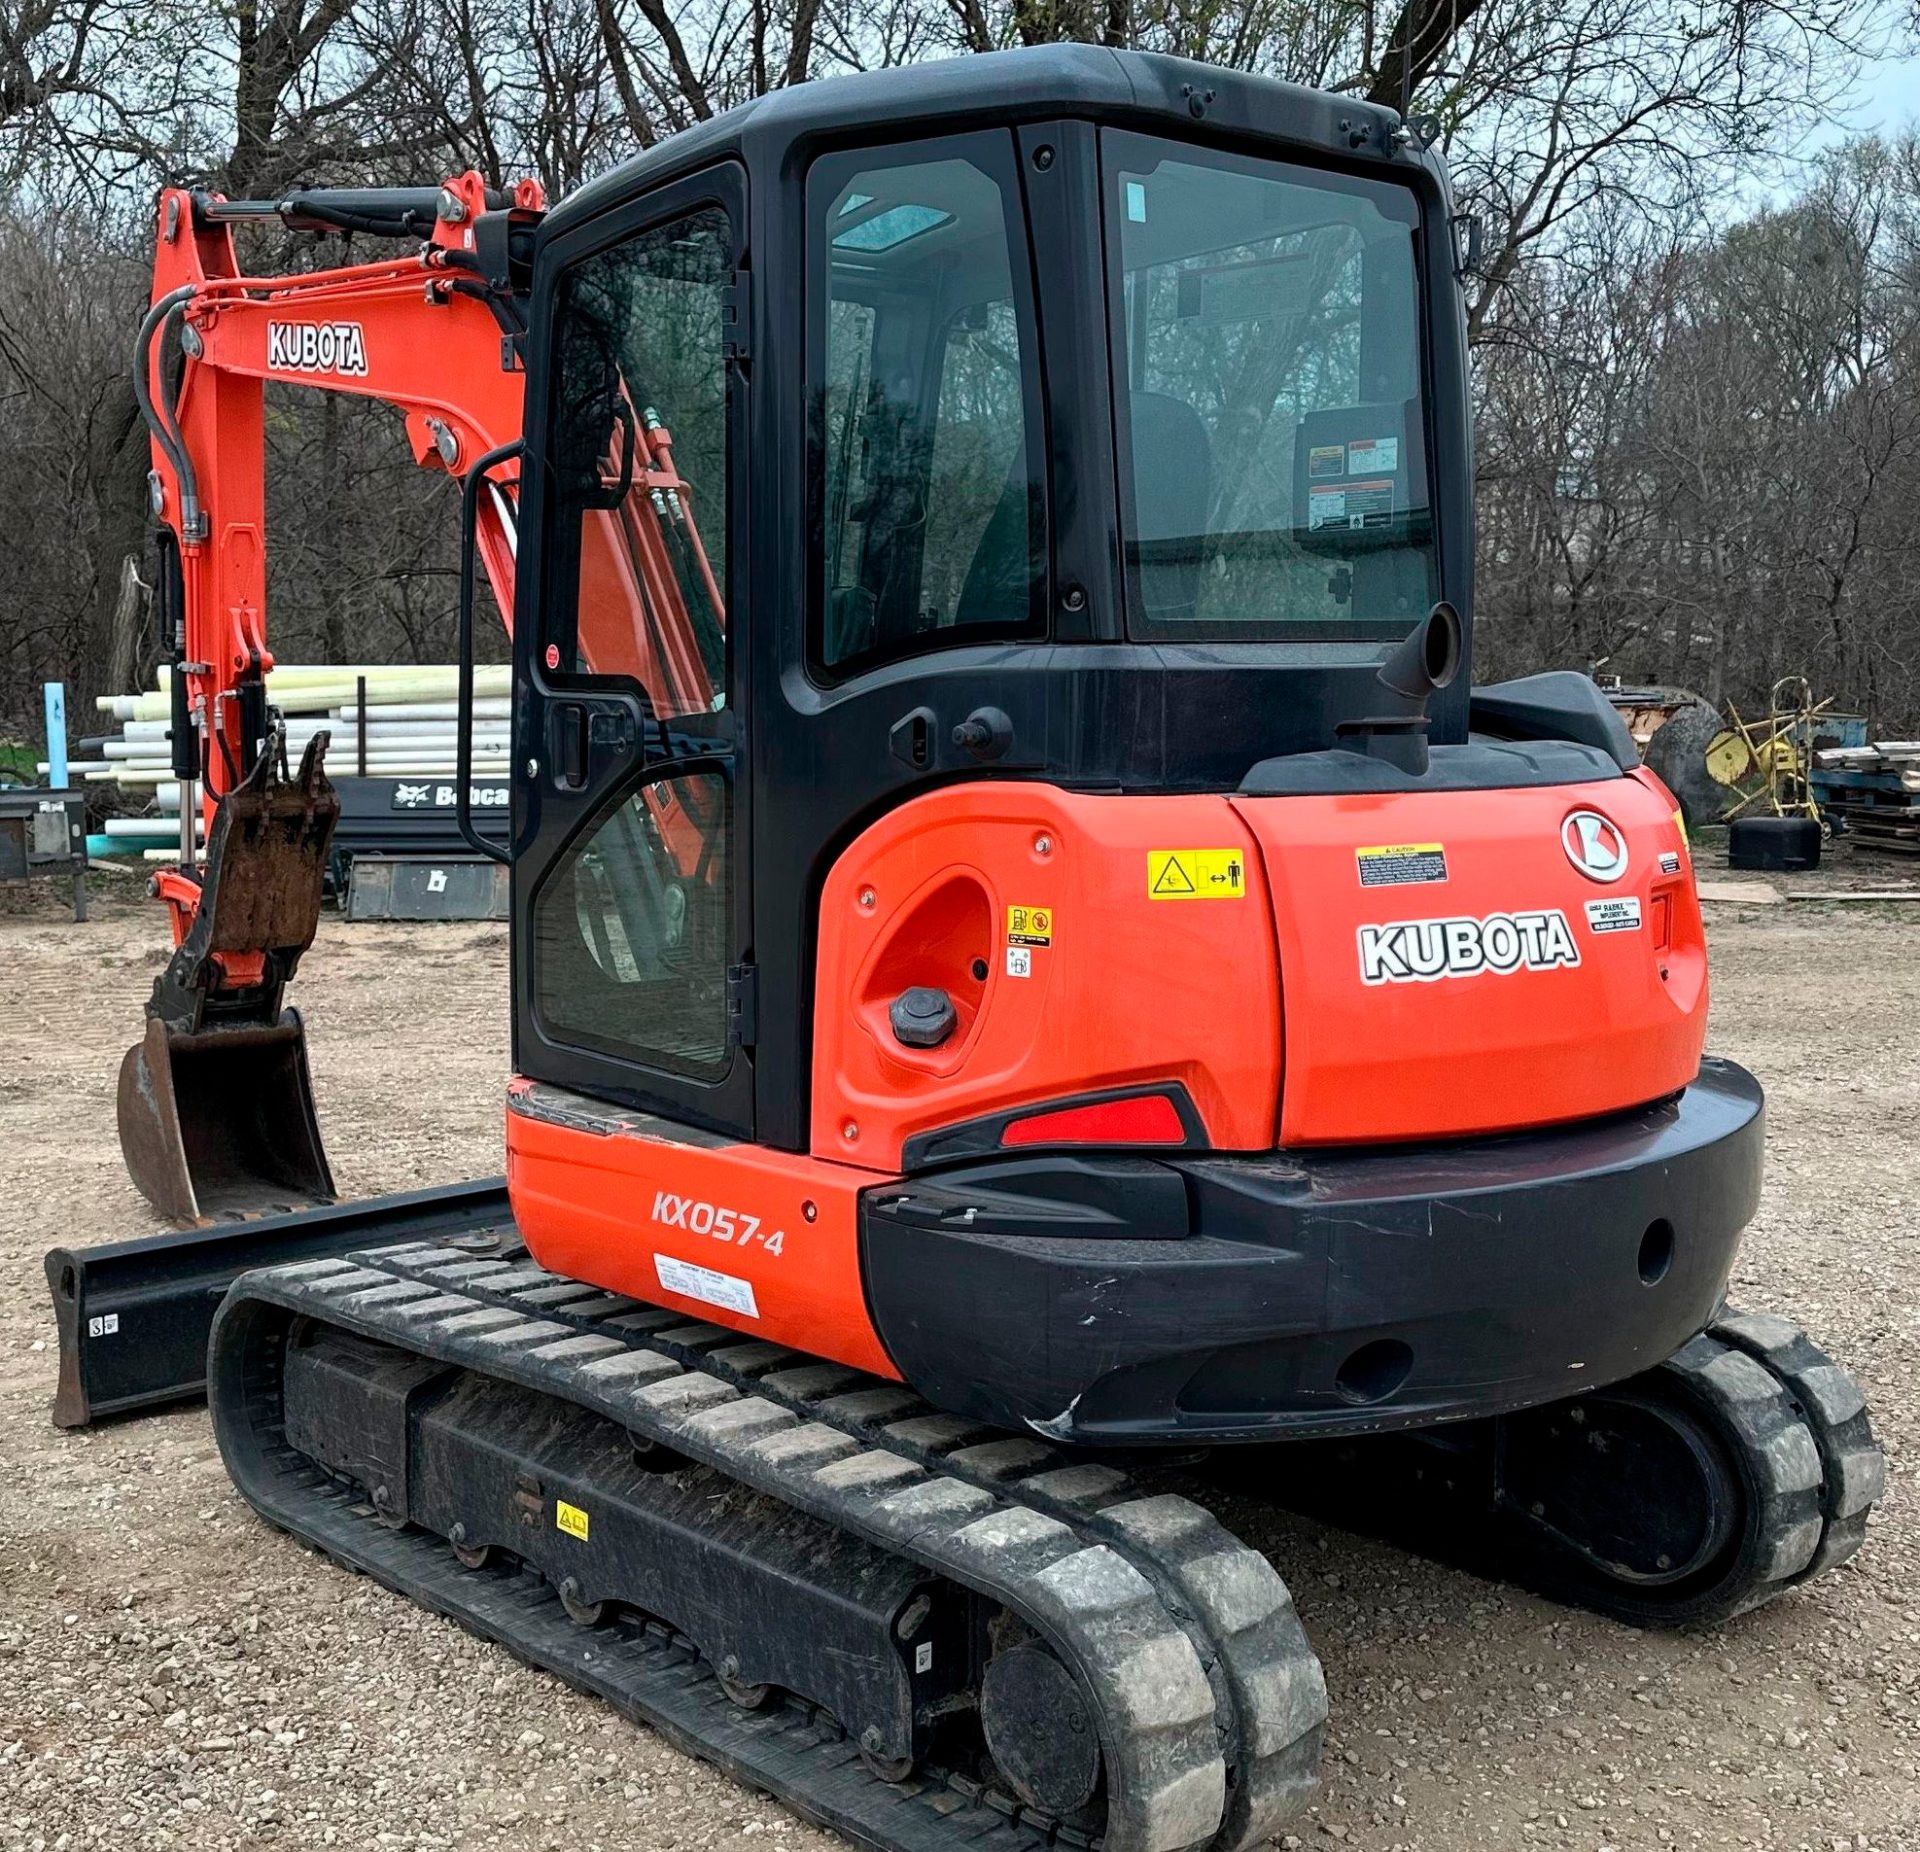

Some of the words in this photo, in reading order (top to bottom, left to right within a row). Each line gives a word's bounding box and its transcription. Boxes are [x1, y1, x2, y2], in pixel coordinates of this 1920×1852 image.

[269, 322, 366, 371] KUBOTA
[435, 786, 510, 806] Bbca
[1361, 914, 1578, 979] KUBOTA
[651, 1191, 785, 1257] KX057-4
